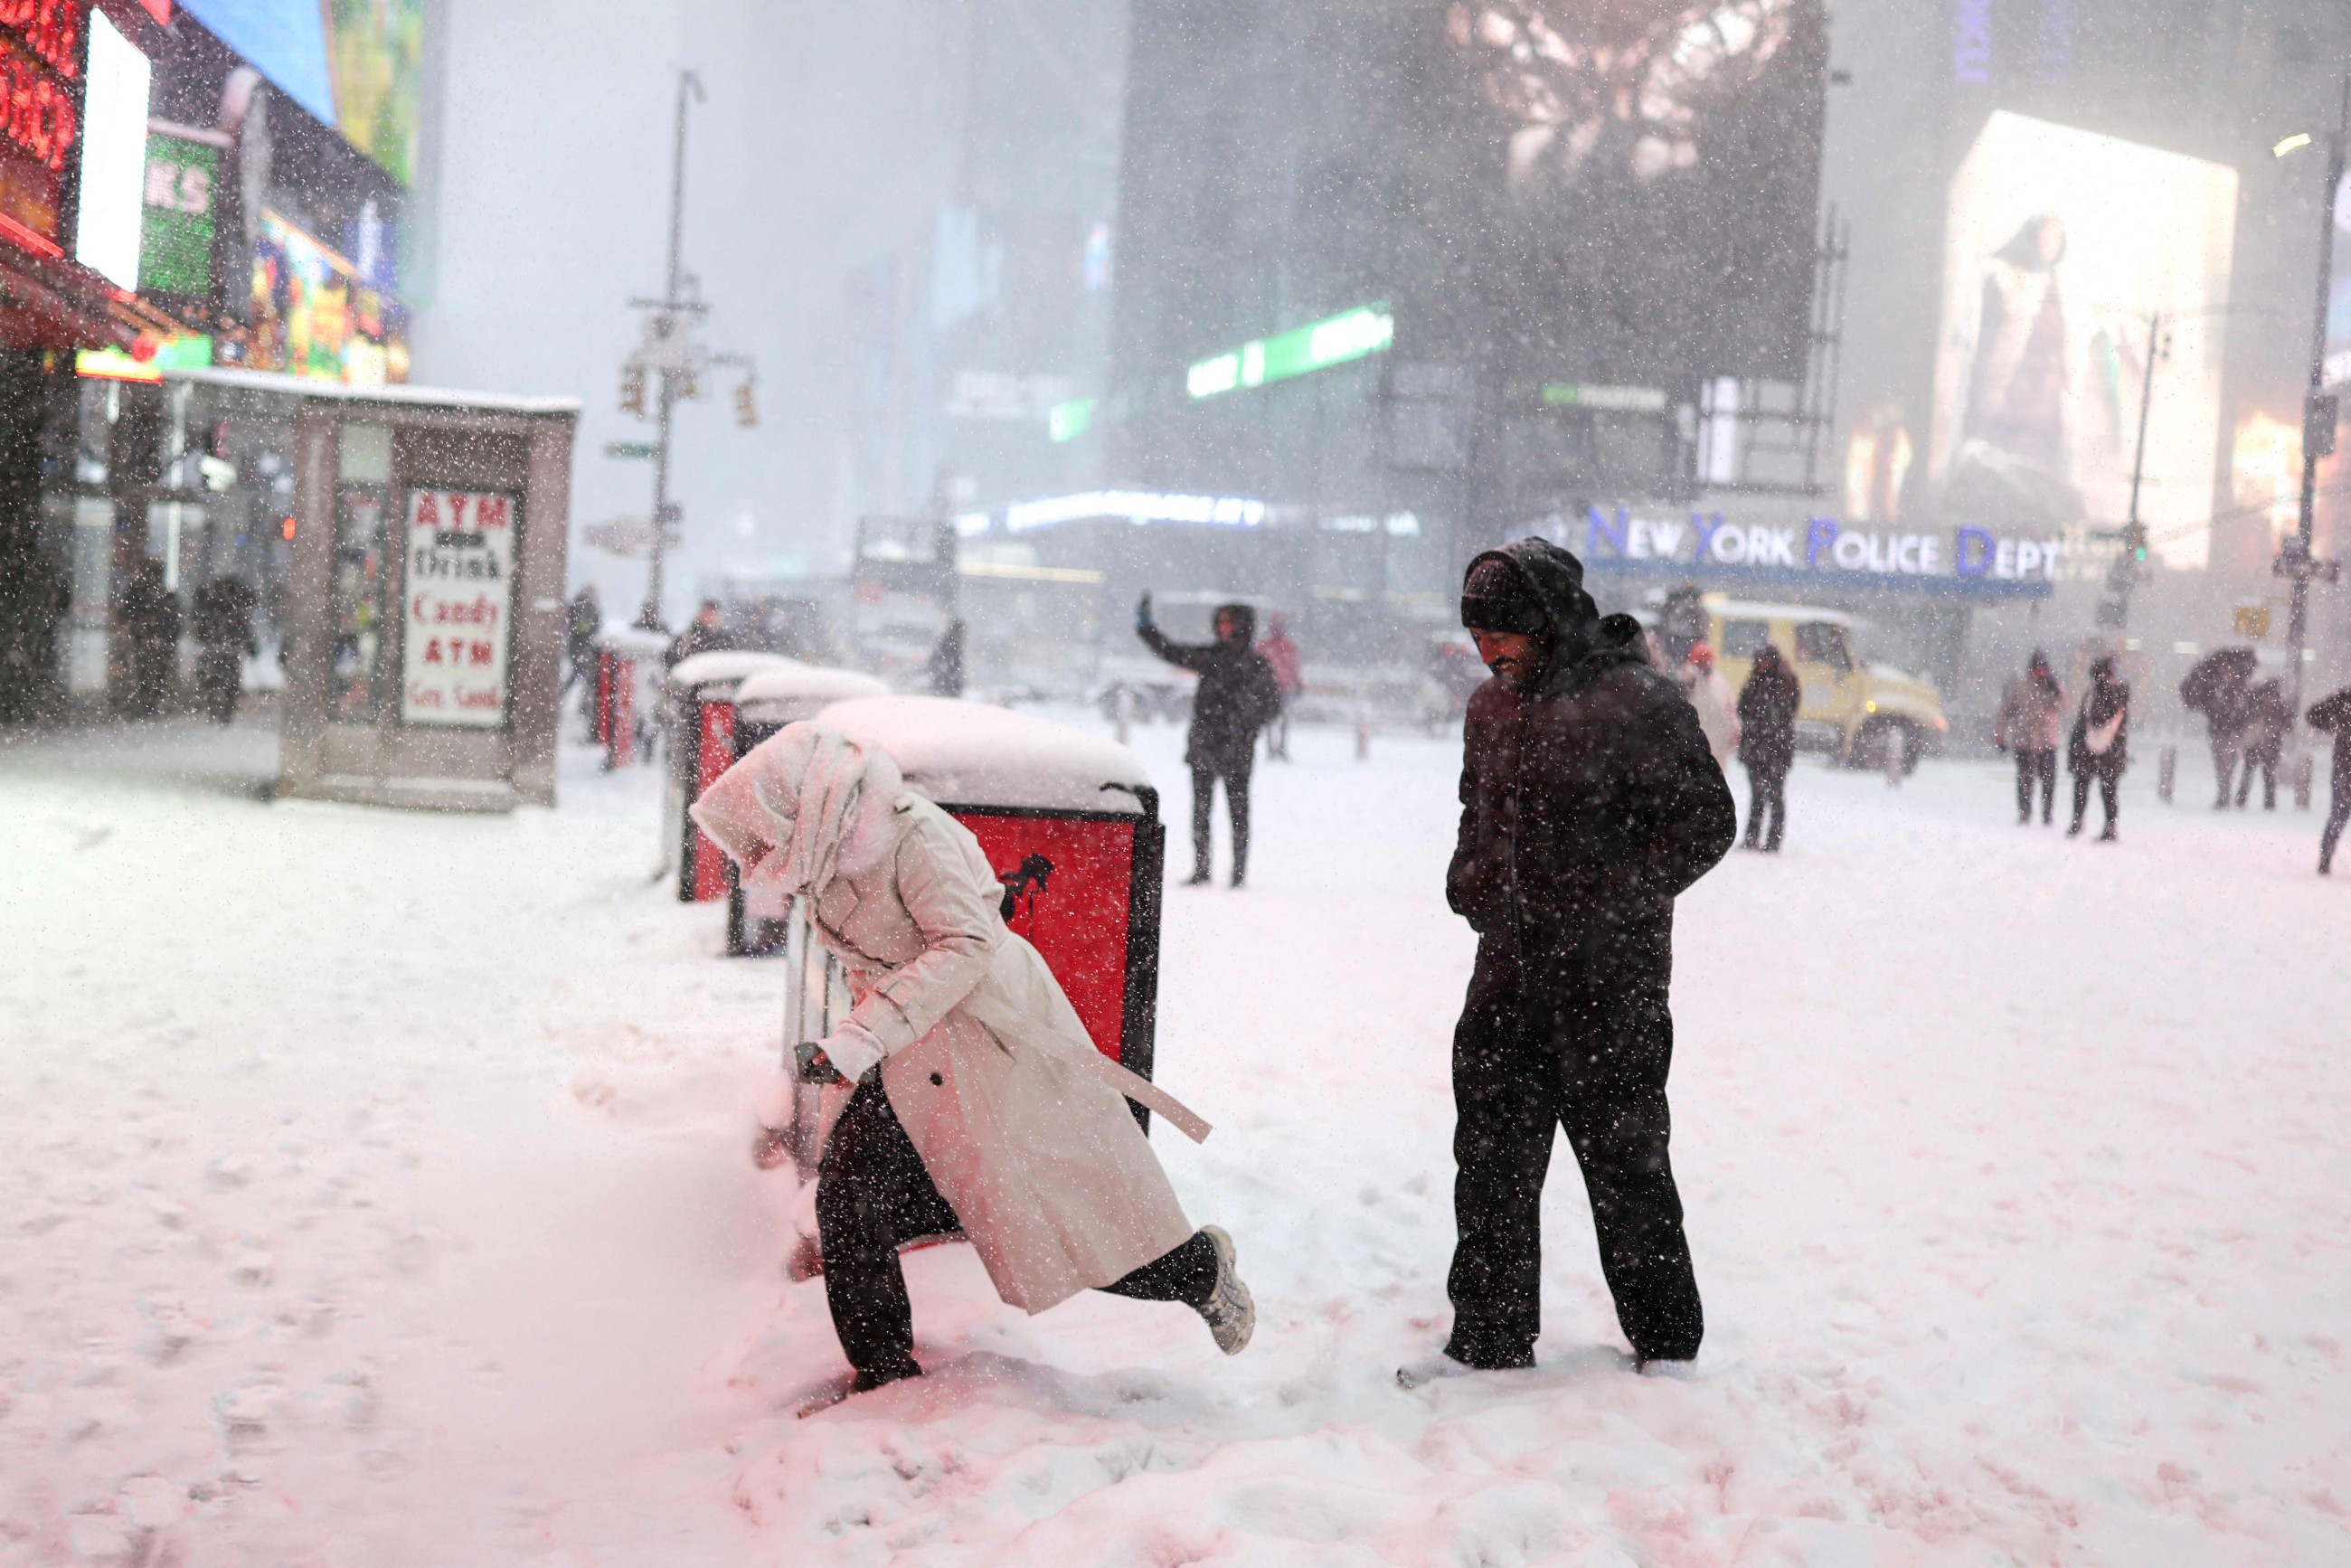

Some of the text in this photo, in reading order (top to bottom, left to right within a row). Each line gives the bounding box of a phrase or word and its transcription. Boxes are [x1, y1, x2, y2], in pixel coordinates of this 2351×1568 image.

[416, 492, 506, 529] ATM
[1587, 505, 1683, 558] NEW
[1691, 511, 1794, 565] YORK
[1808, 516, 1939, 573] POLICE
[1957, 524, 2058, 580] DEPT
[415, 549, 501, 580] Drink
[412, 592, 498, 635] Candy
[424, 638, 493, 666] ATM
